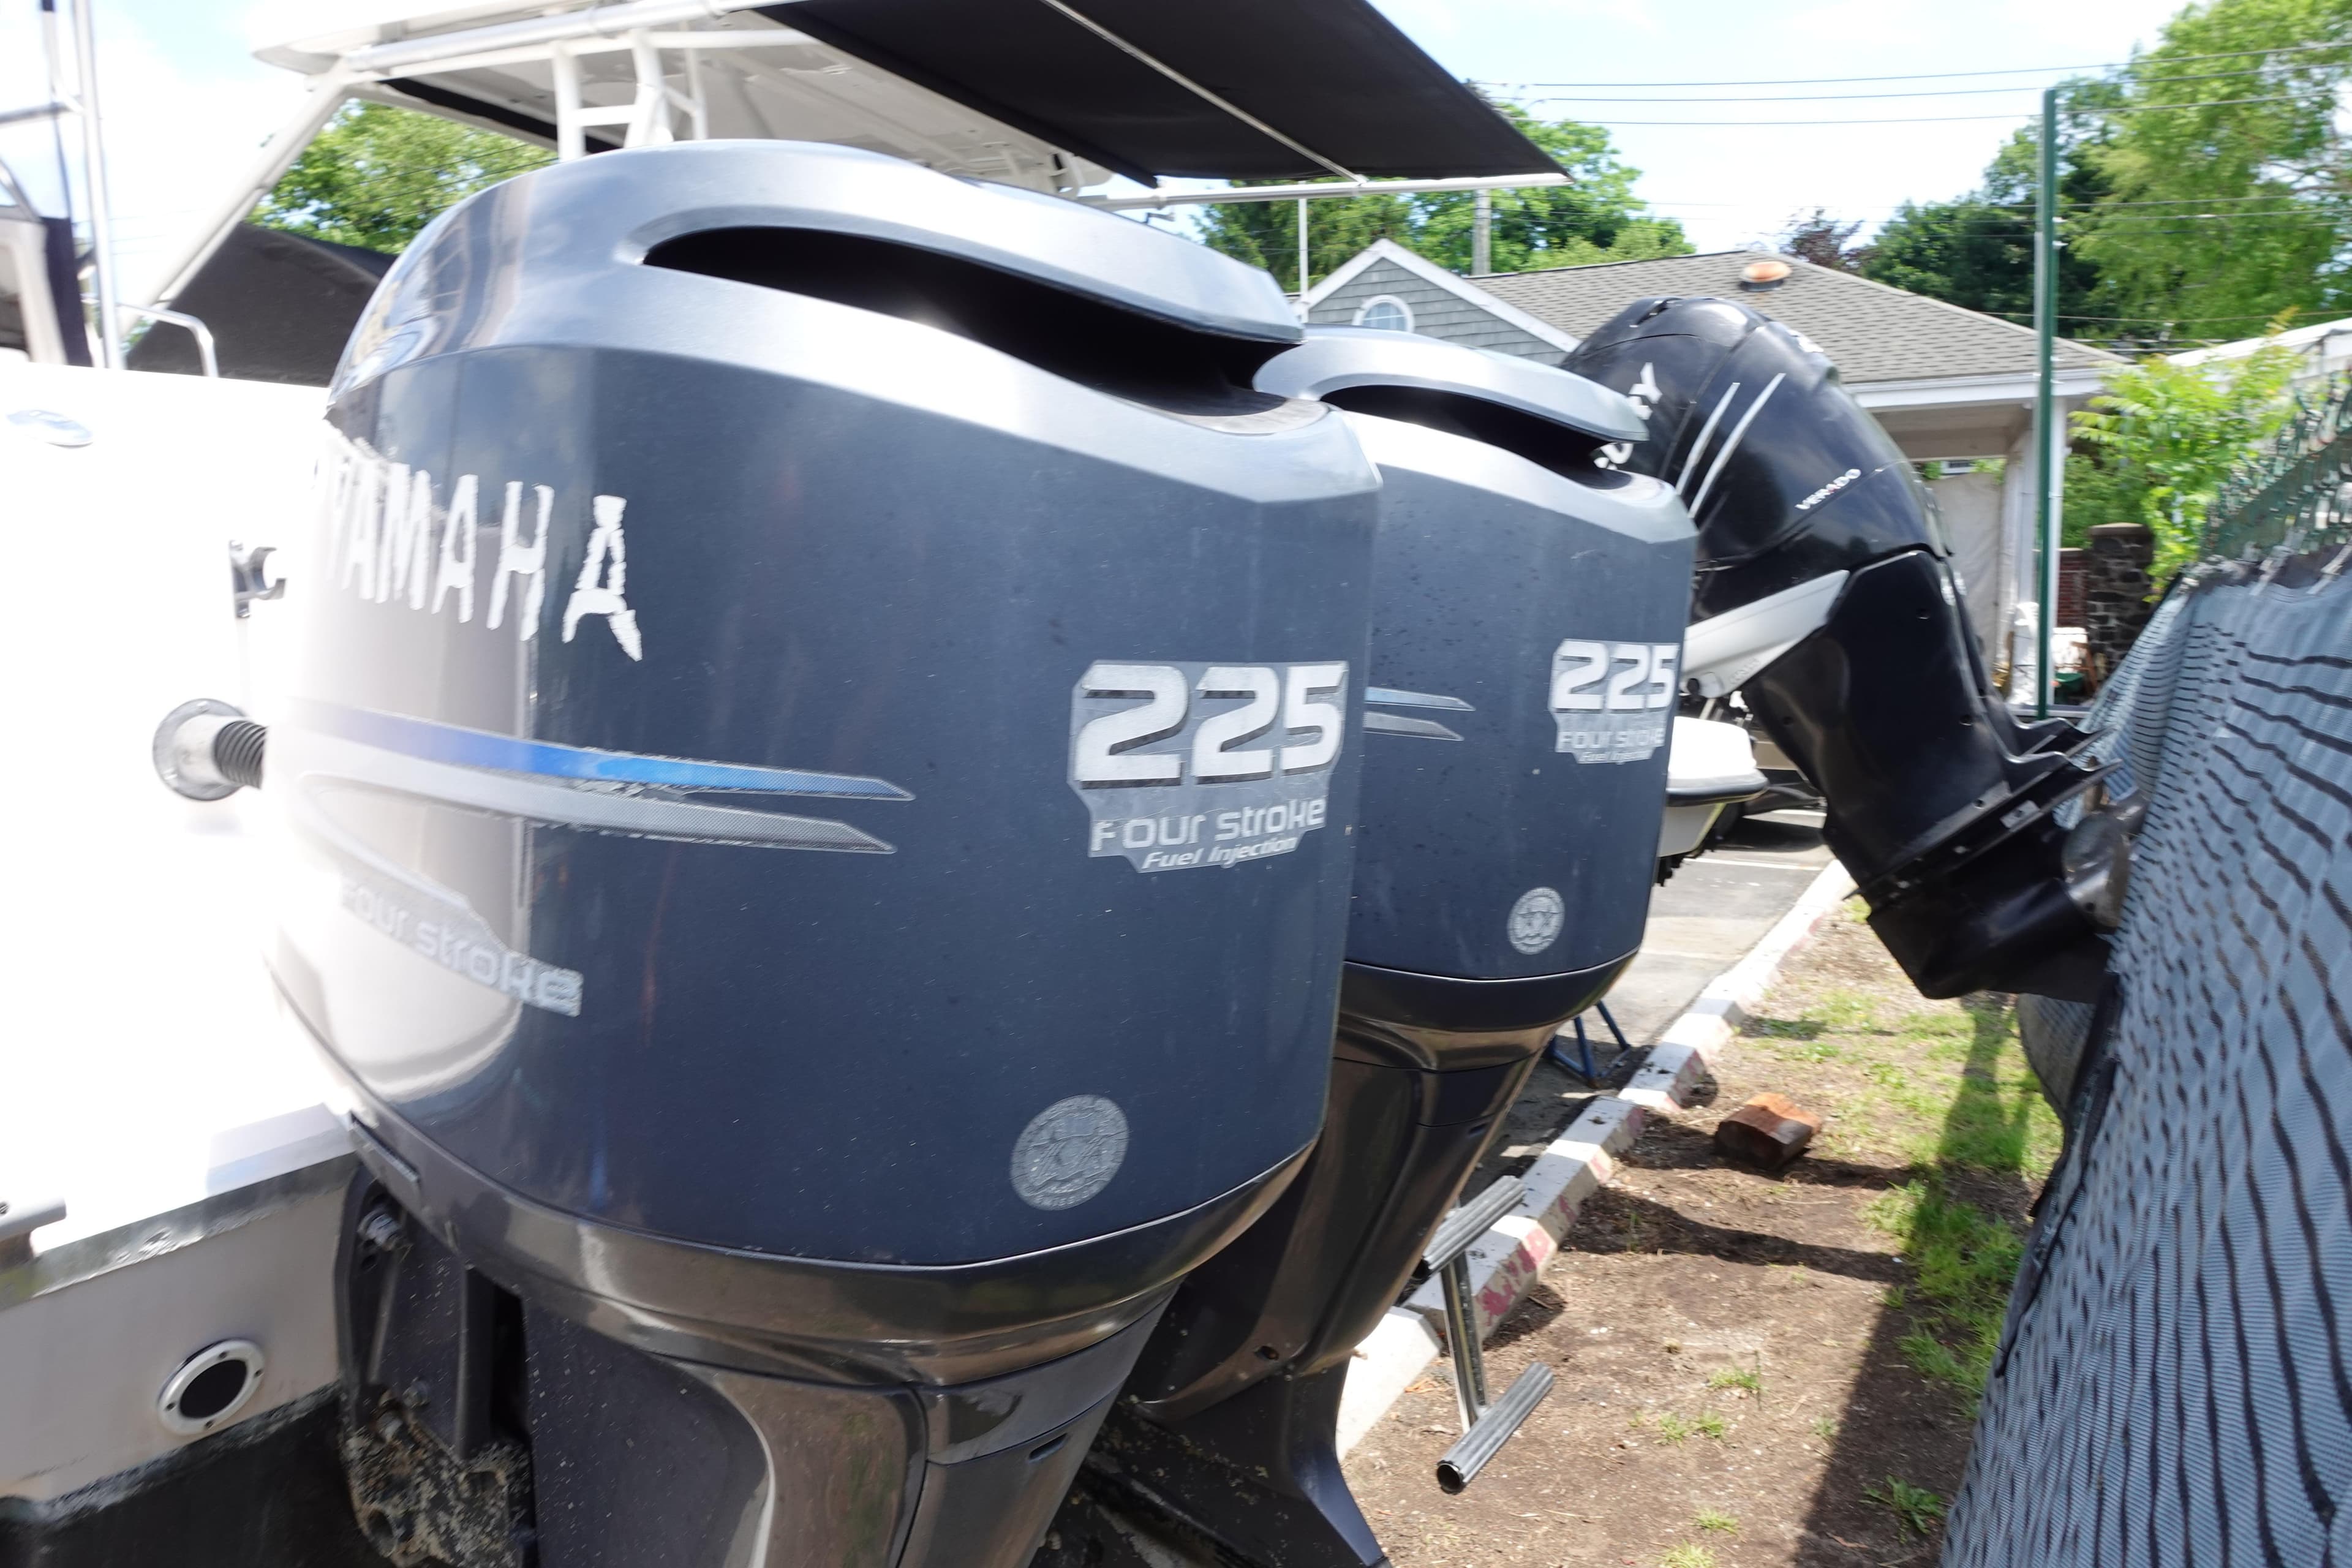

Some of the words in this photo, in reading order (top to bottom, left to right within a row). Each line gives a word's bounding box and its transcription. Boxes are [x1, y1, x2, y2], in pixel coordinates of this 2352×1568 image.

[1551, 639, 1679, 714] 225
[1074, 663, 1348, 790] 225
[1141, 848, 1201, 870] Fuel
[1207, 835, 1297, 869] Injection
